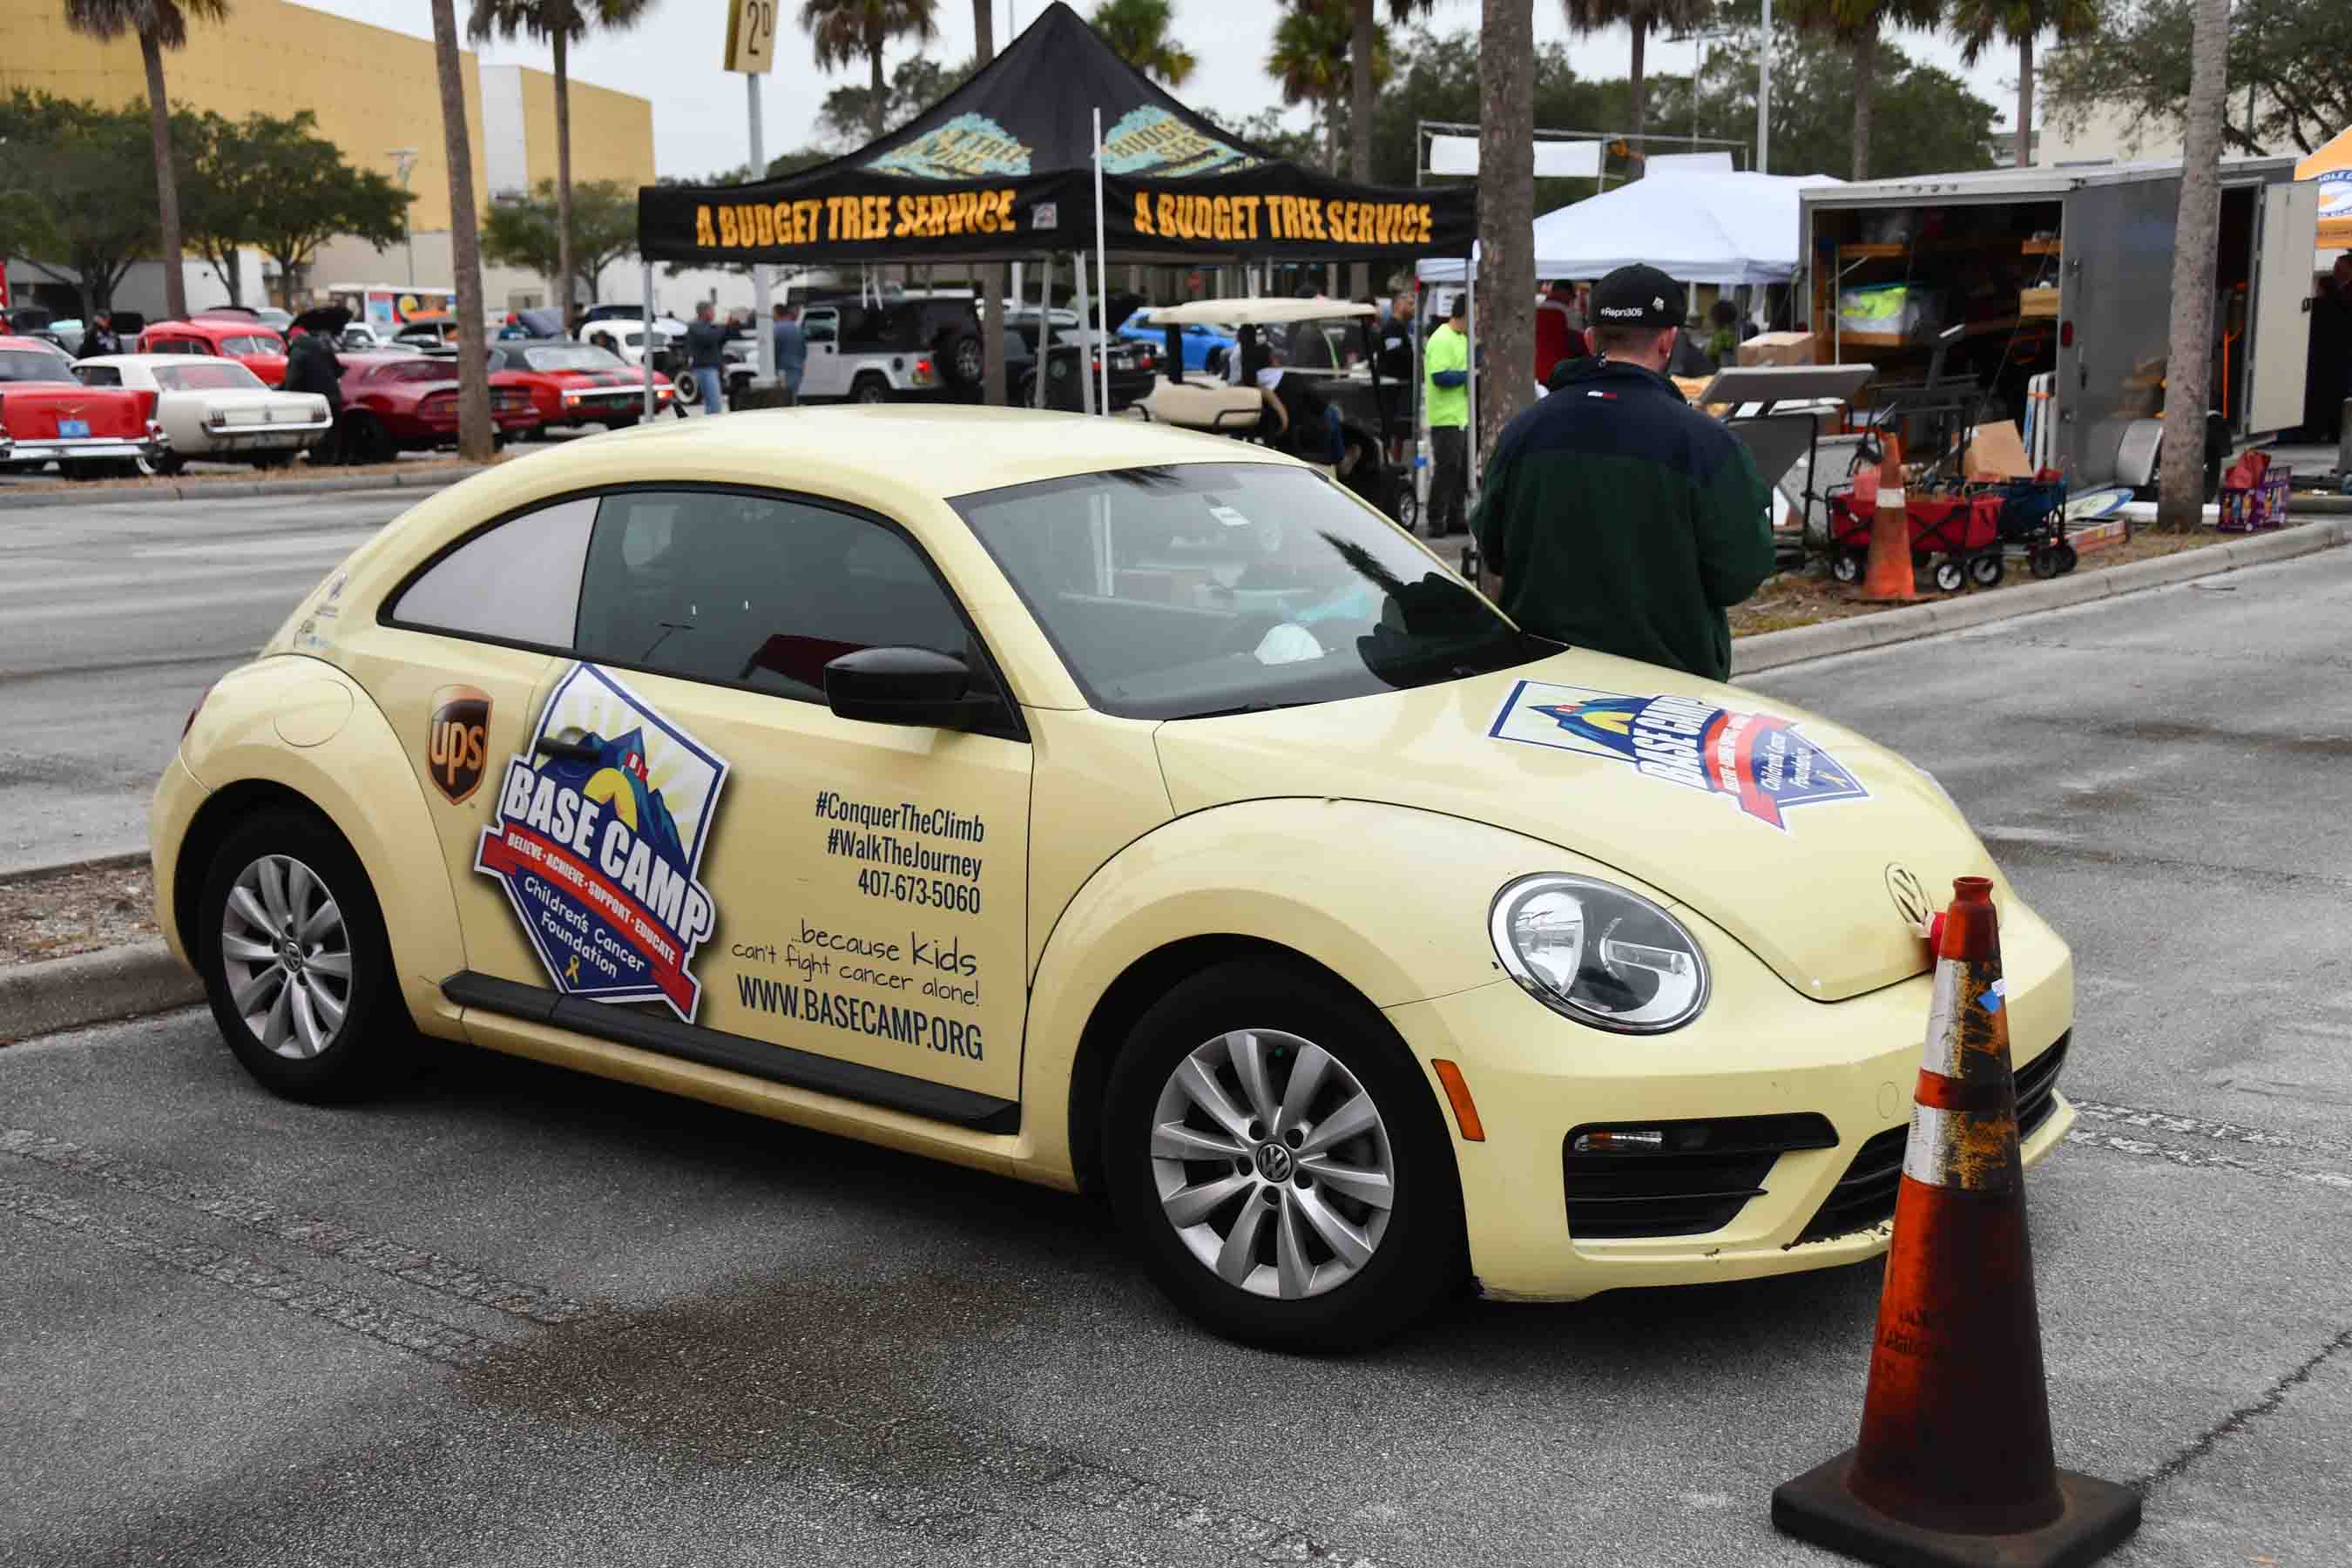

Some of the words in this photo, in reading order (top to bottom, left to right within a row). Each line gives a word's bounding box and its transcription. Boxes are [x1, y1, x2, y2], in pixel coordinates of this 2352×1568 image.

[696, 204, 716, 247] A
[718, 199, 822, 248] BUDGET
[826, 195, 891, 240] TREE
[894, 189, 1017, 237] SERVICE
[1134, 192, 1156, 235] A
[1157, 193, 1260, 240] BUDGET
[1265, 195, 1327, 240] TREE
[1328, 199, 1432, 244] SERVICE
[815, 791, 985, 843] #ConquerTheClimb
[504, 765, 600, 859] BASE
[599, 820, 709, 943] CAMP
[828, 828, 983, 882] #WalkTheJourney
[507, 832, 544, 862] BELIEVE
[545, 852, 586, 888] ACHIEVE
[587, 880, 632, 923] SUPPORT
[634, 917, 676, 965] EDUCATE
[858, 868, 982, 915] 407-673-5060
[524, 876, 590, 934] Children's
[594, 928, 645, 973] Cancer
[541, 910, 618, 979] Foundation
[731, 943, 778, 964] can't
[785, 944, 831, 983] fight
[839, 964, 914, 990] cancer
[922, 977, 981, 1007] alone!
[737, 974, 984, 1061] WWW.BASECAMP.ORG
